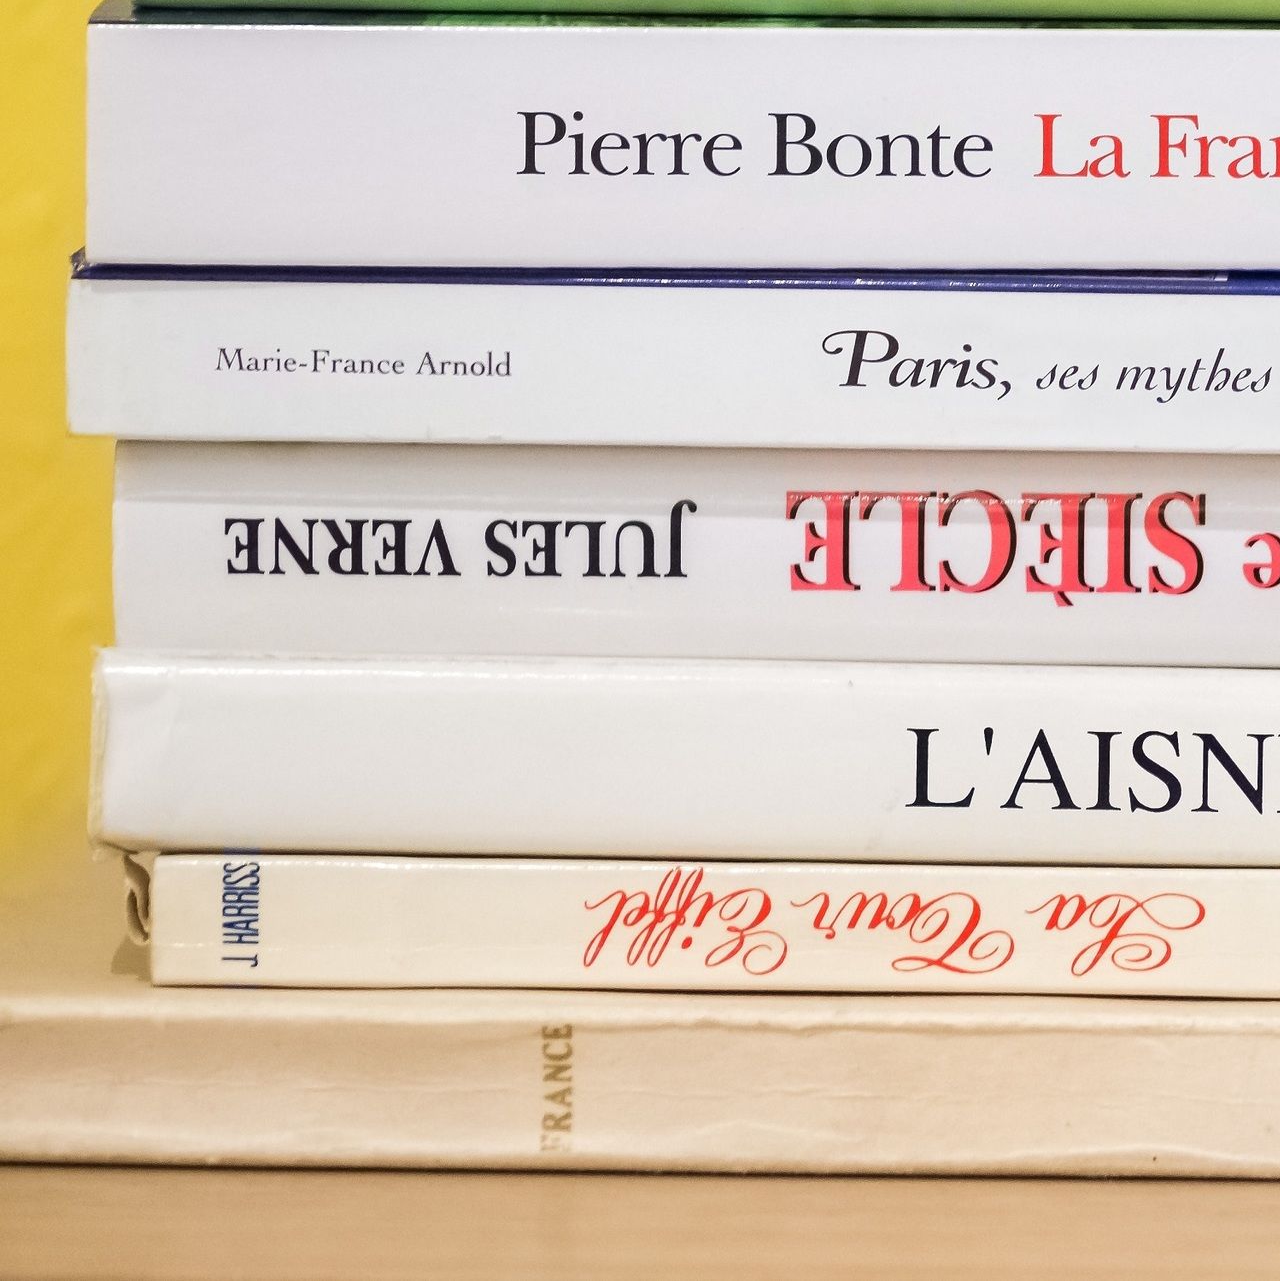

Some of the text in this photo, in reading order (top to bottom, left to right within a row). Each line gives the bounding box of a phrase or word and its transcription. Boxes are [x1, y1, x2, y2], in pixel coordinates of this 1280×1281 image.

[517, 111, 742, 176] Pierre
[768, 113, 993, 177] Bonte
[1034, 115, 1130, 178] La
[217, 348, 509, 375] Marie-France Arnold
[822, 331, 1011, 399] Paris,
[1036, 365, 1098, 390] ses
[1117, 349, 1271, 403] mythes
[225, 500, 697, 577] JULES VERNE
[787, 490, 1205, 606] SIÈCLE
[221, 861, 261, 968] J HARRISS
[584, 868, 1206, 976] La Tour Eiffel
